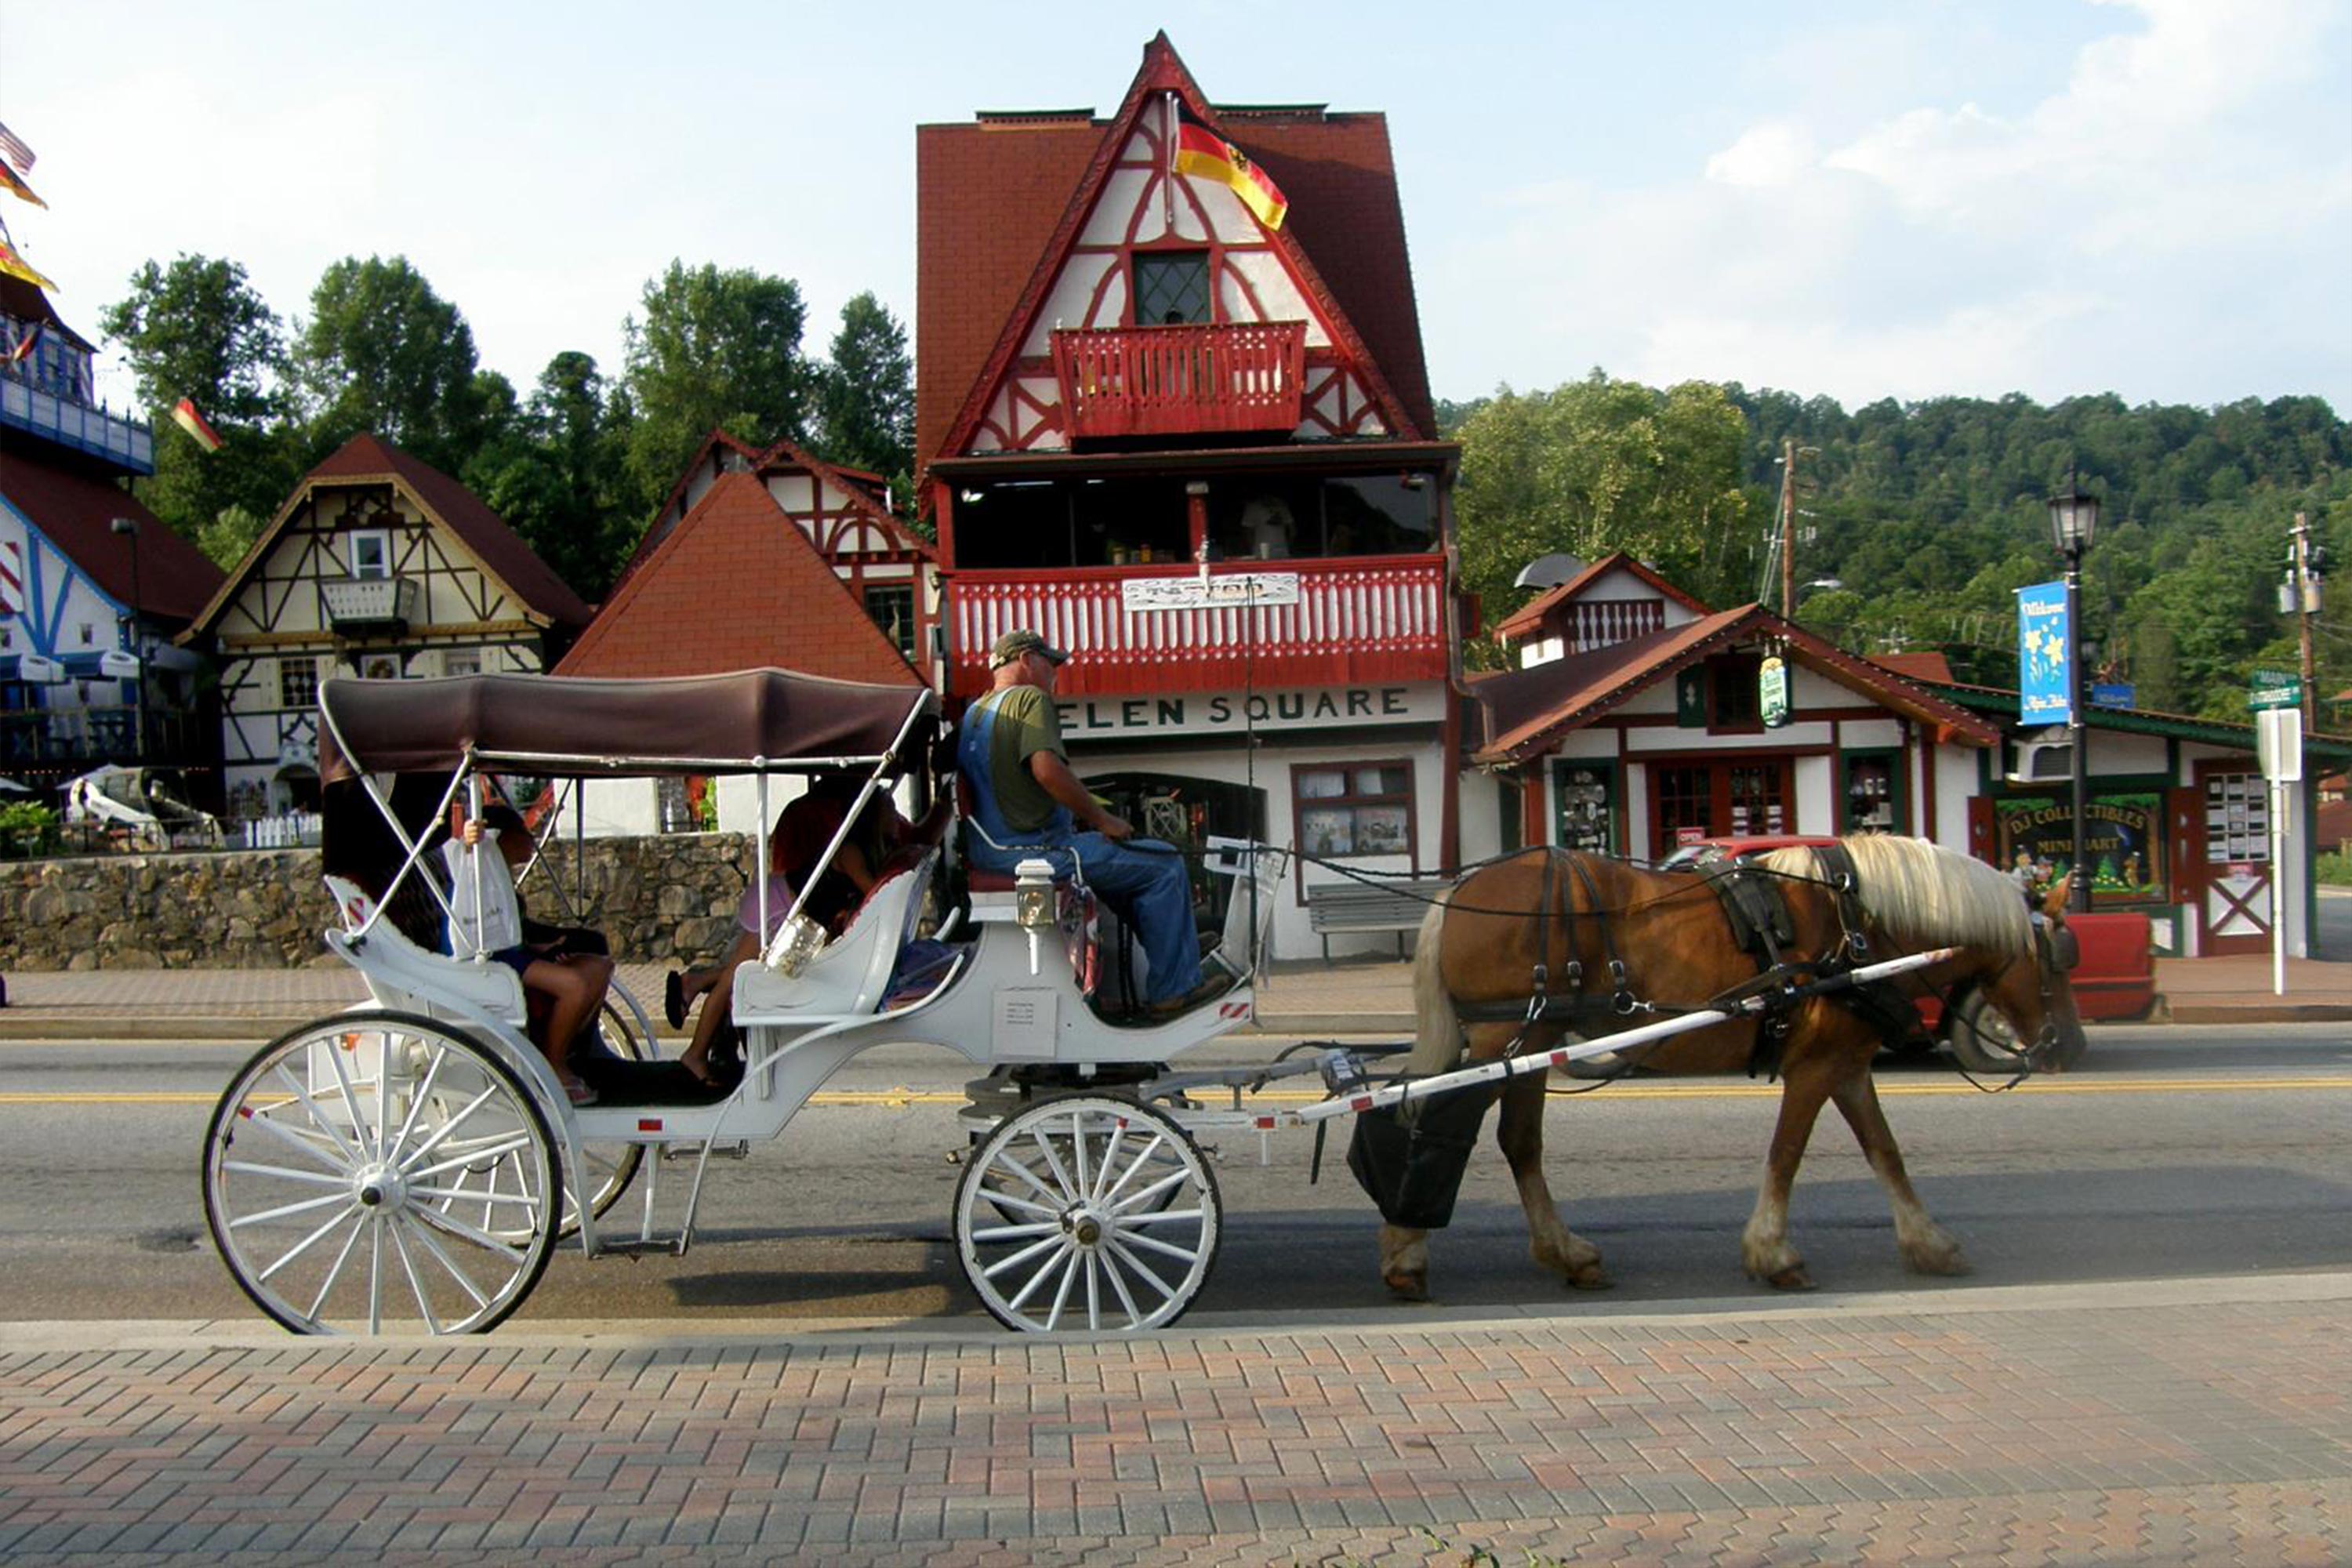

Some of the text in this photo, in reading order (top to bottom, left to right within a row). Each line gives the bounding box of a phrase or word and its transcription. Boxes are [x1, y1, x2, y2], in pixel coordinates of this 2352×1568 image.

[1058, 688, 1409, 730] ELEN SQUARE
[2011, 804, 2147, 835] DJ COLLCTIBLES
[2037, 840, 2073, 854] MINI
